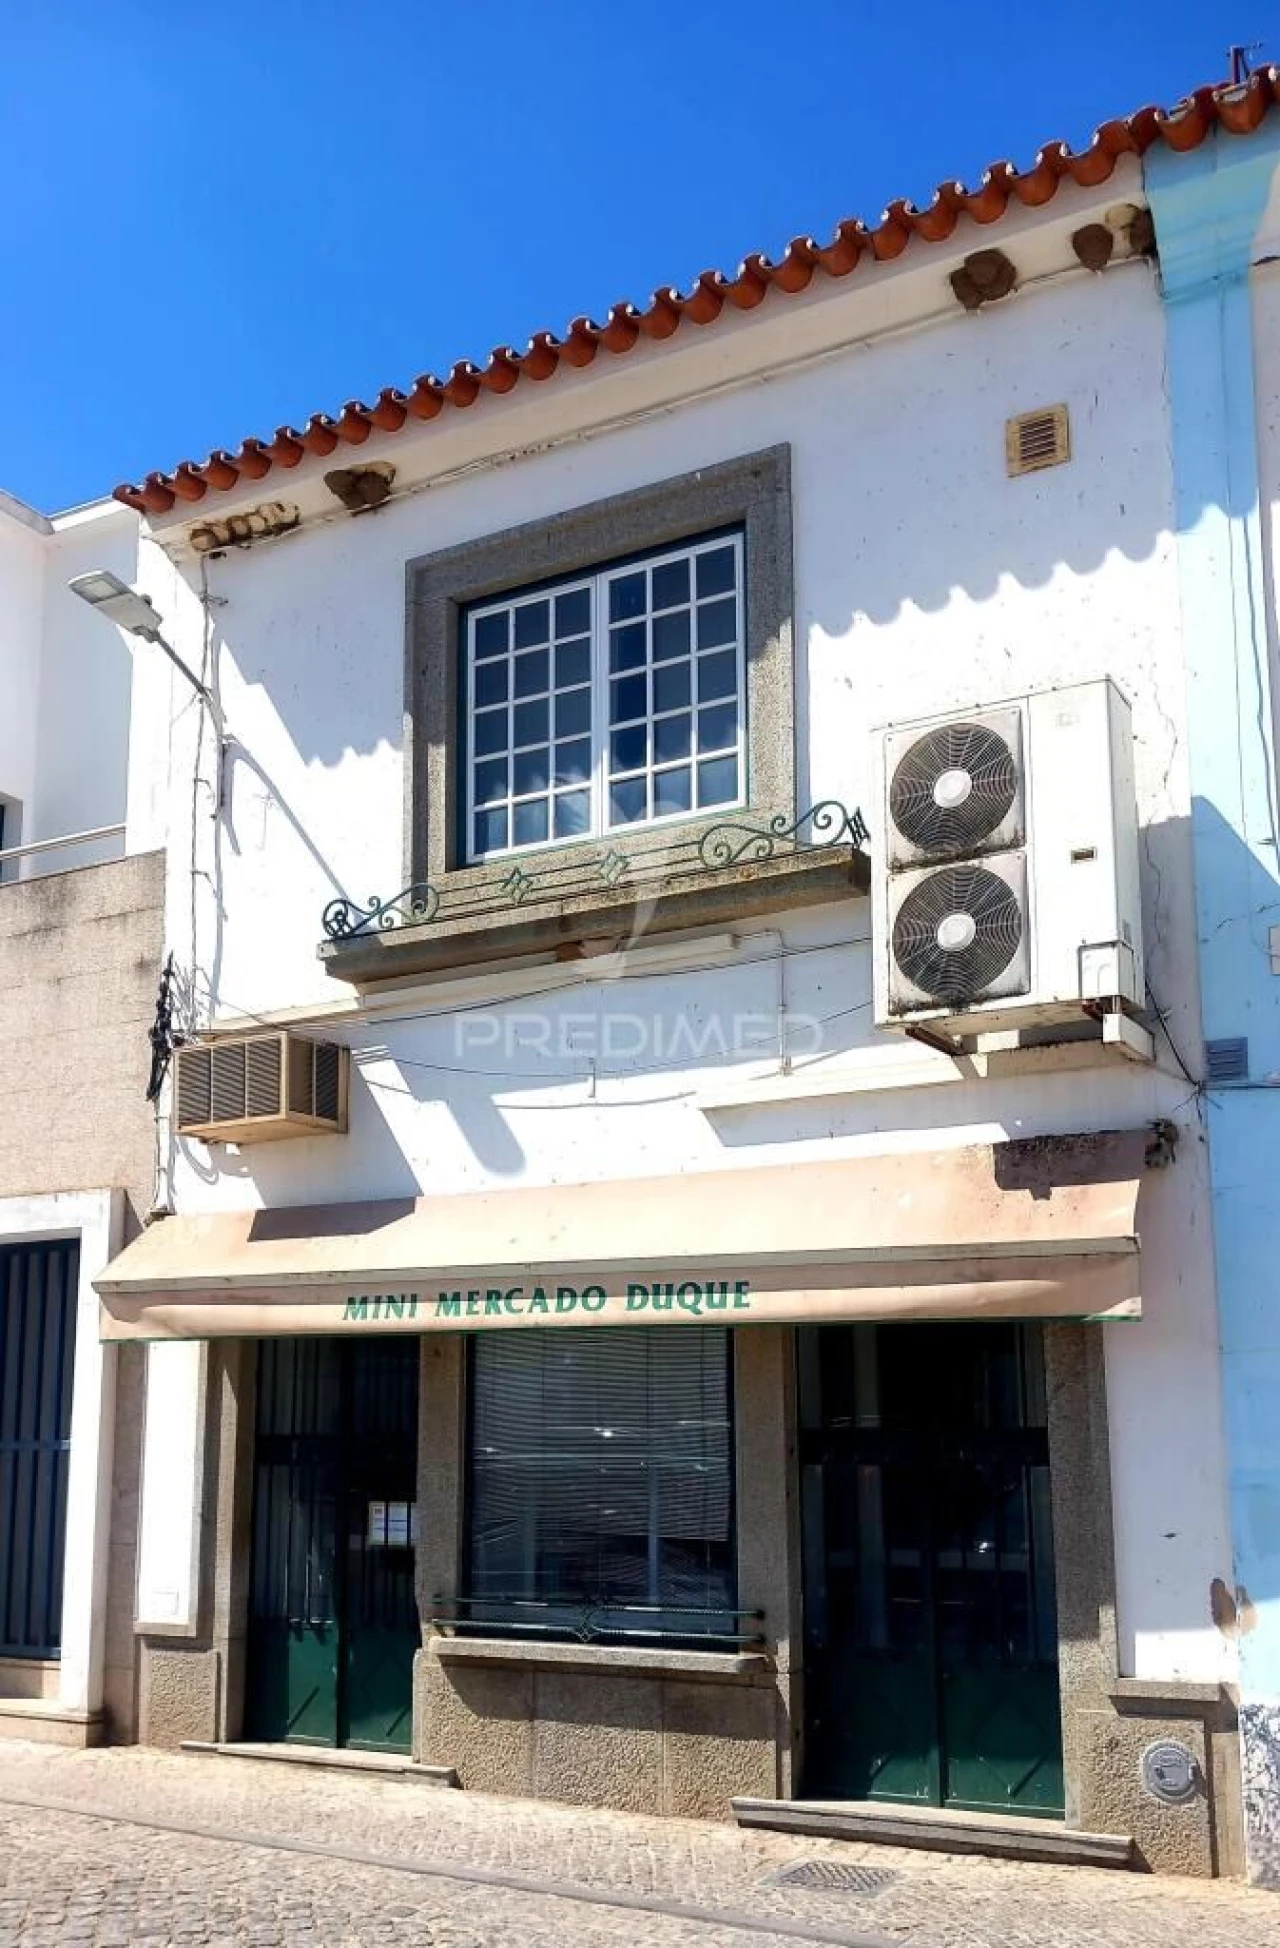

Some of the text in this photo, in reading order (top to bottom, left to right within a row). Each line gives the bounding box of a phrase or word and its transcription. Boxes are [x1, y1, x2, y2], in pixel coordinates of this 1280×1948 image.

[343, 1280, 751, 1321] MINI MERCADO DUQUE
